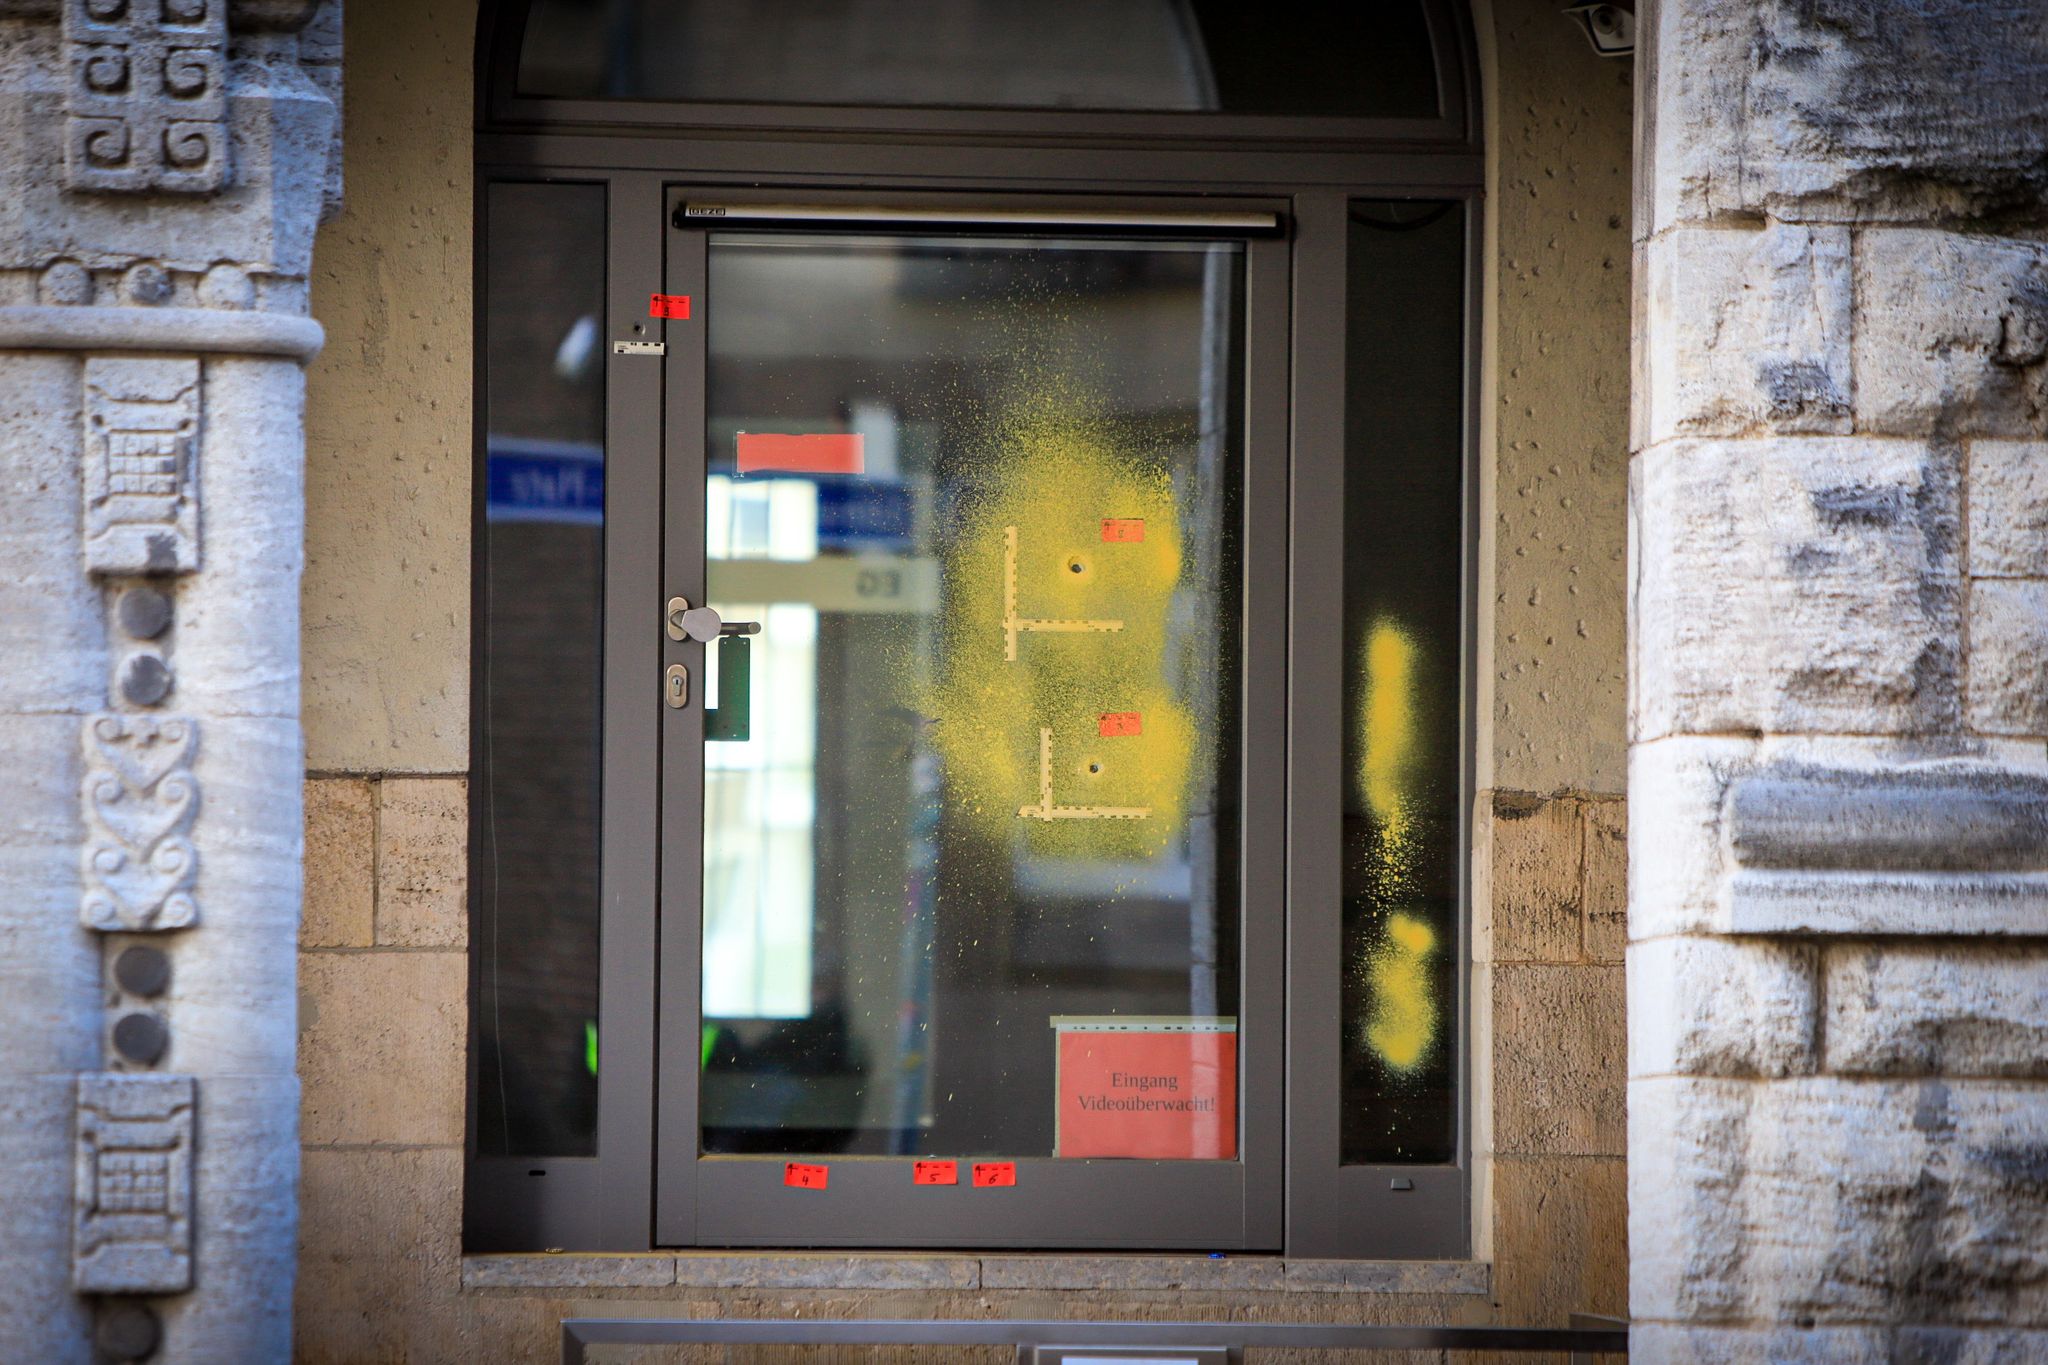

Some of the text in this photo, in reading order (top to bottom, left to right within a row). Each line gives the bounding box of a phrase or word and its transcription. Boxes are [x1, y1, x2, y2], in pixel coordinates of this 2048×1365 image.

[1112, 1072, 1178, 1091] Eingang
[1078, 1095, 1216, 1112] Videoüberwacht!
[929, 1172, 941, 1182] 5
[988, 1173, 999, 1184] 6
